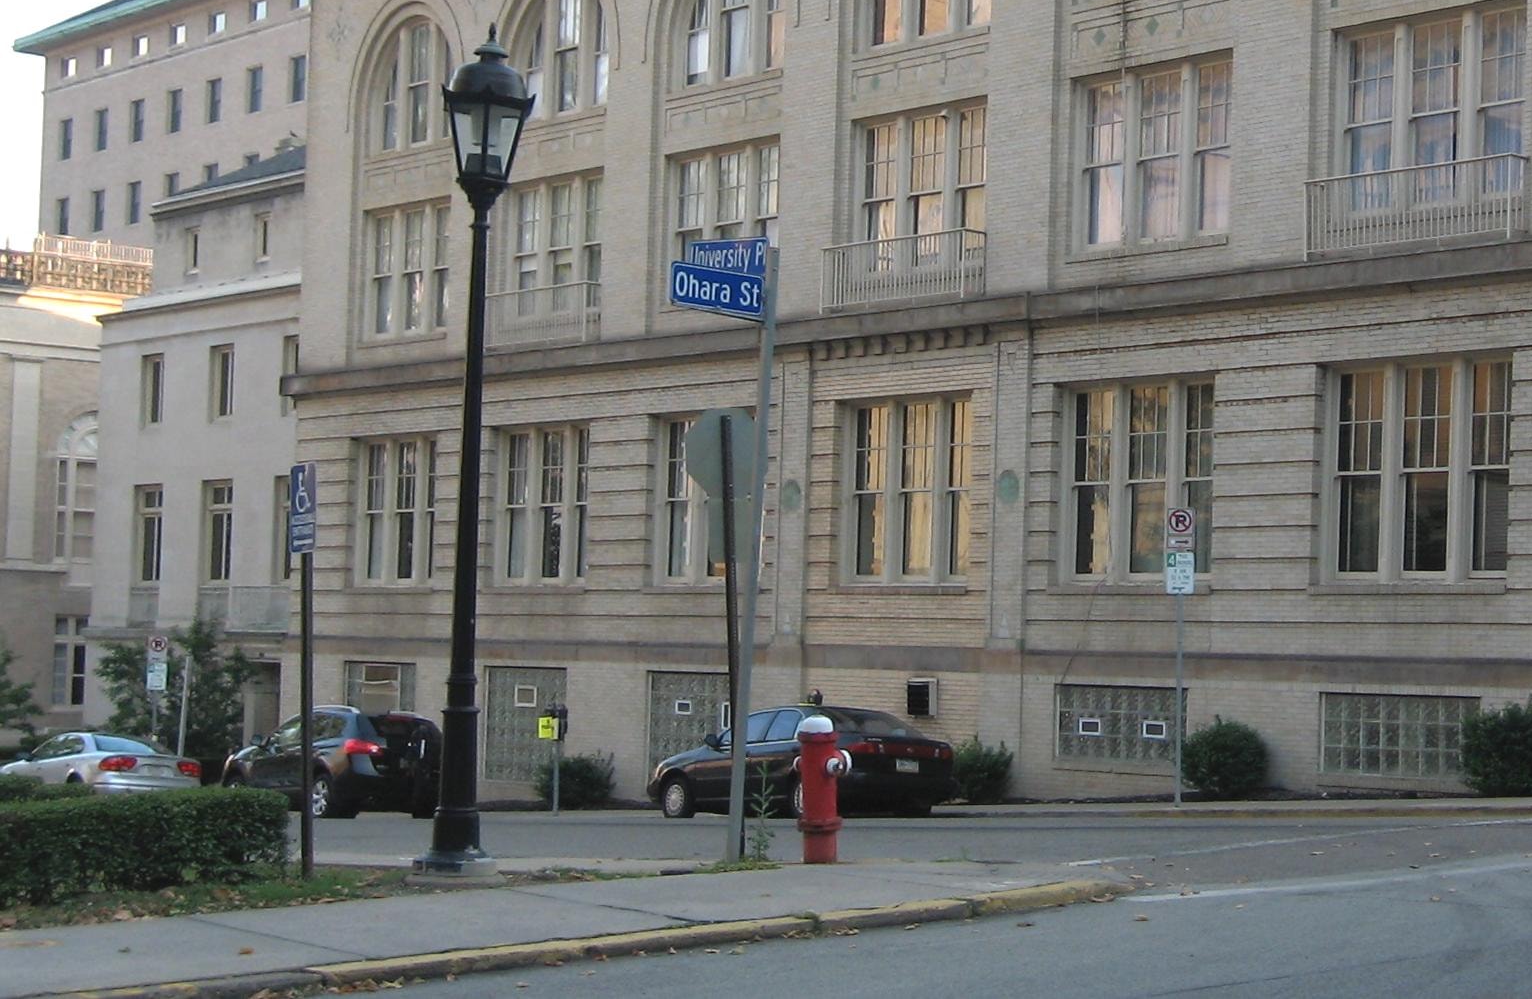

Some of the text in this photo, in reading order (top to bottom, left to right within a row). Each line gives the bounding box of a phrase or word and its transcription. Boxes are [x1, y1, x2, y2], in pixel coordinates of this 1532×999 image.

[690, 243, 751, 273] University
[675, 271, 760, 308] Ohara St
